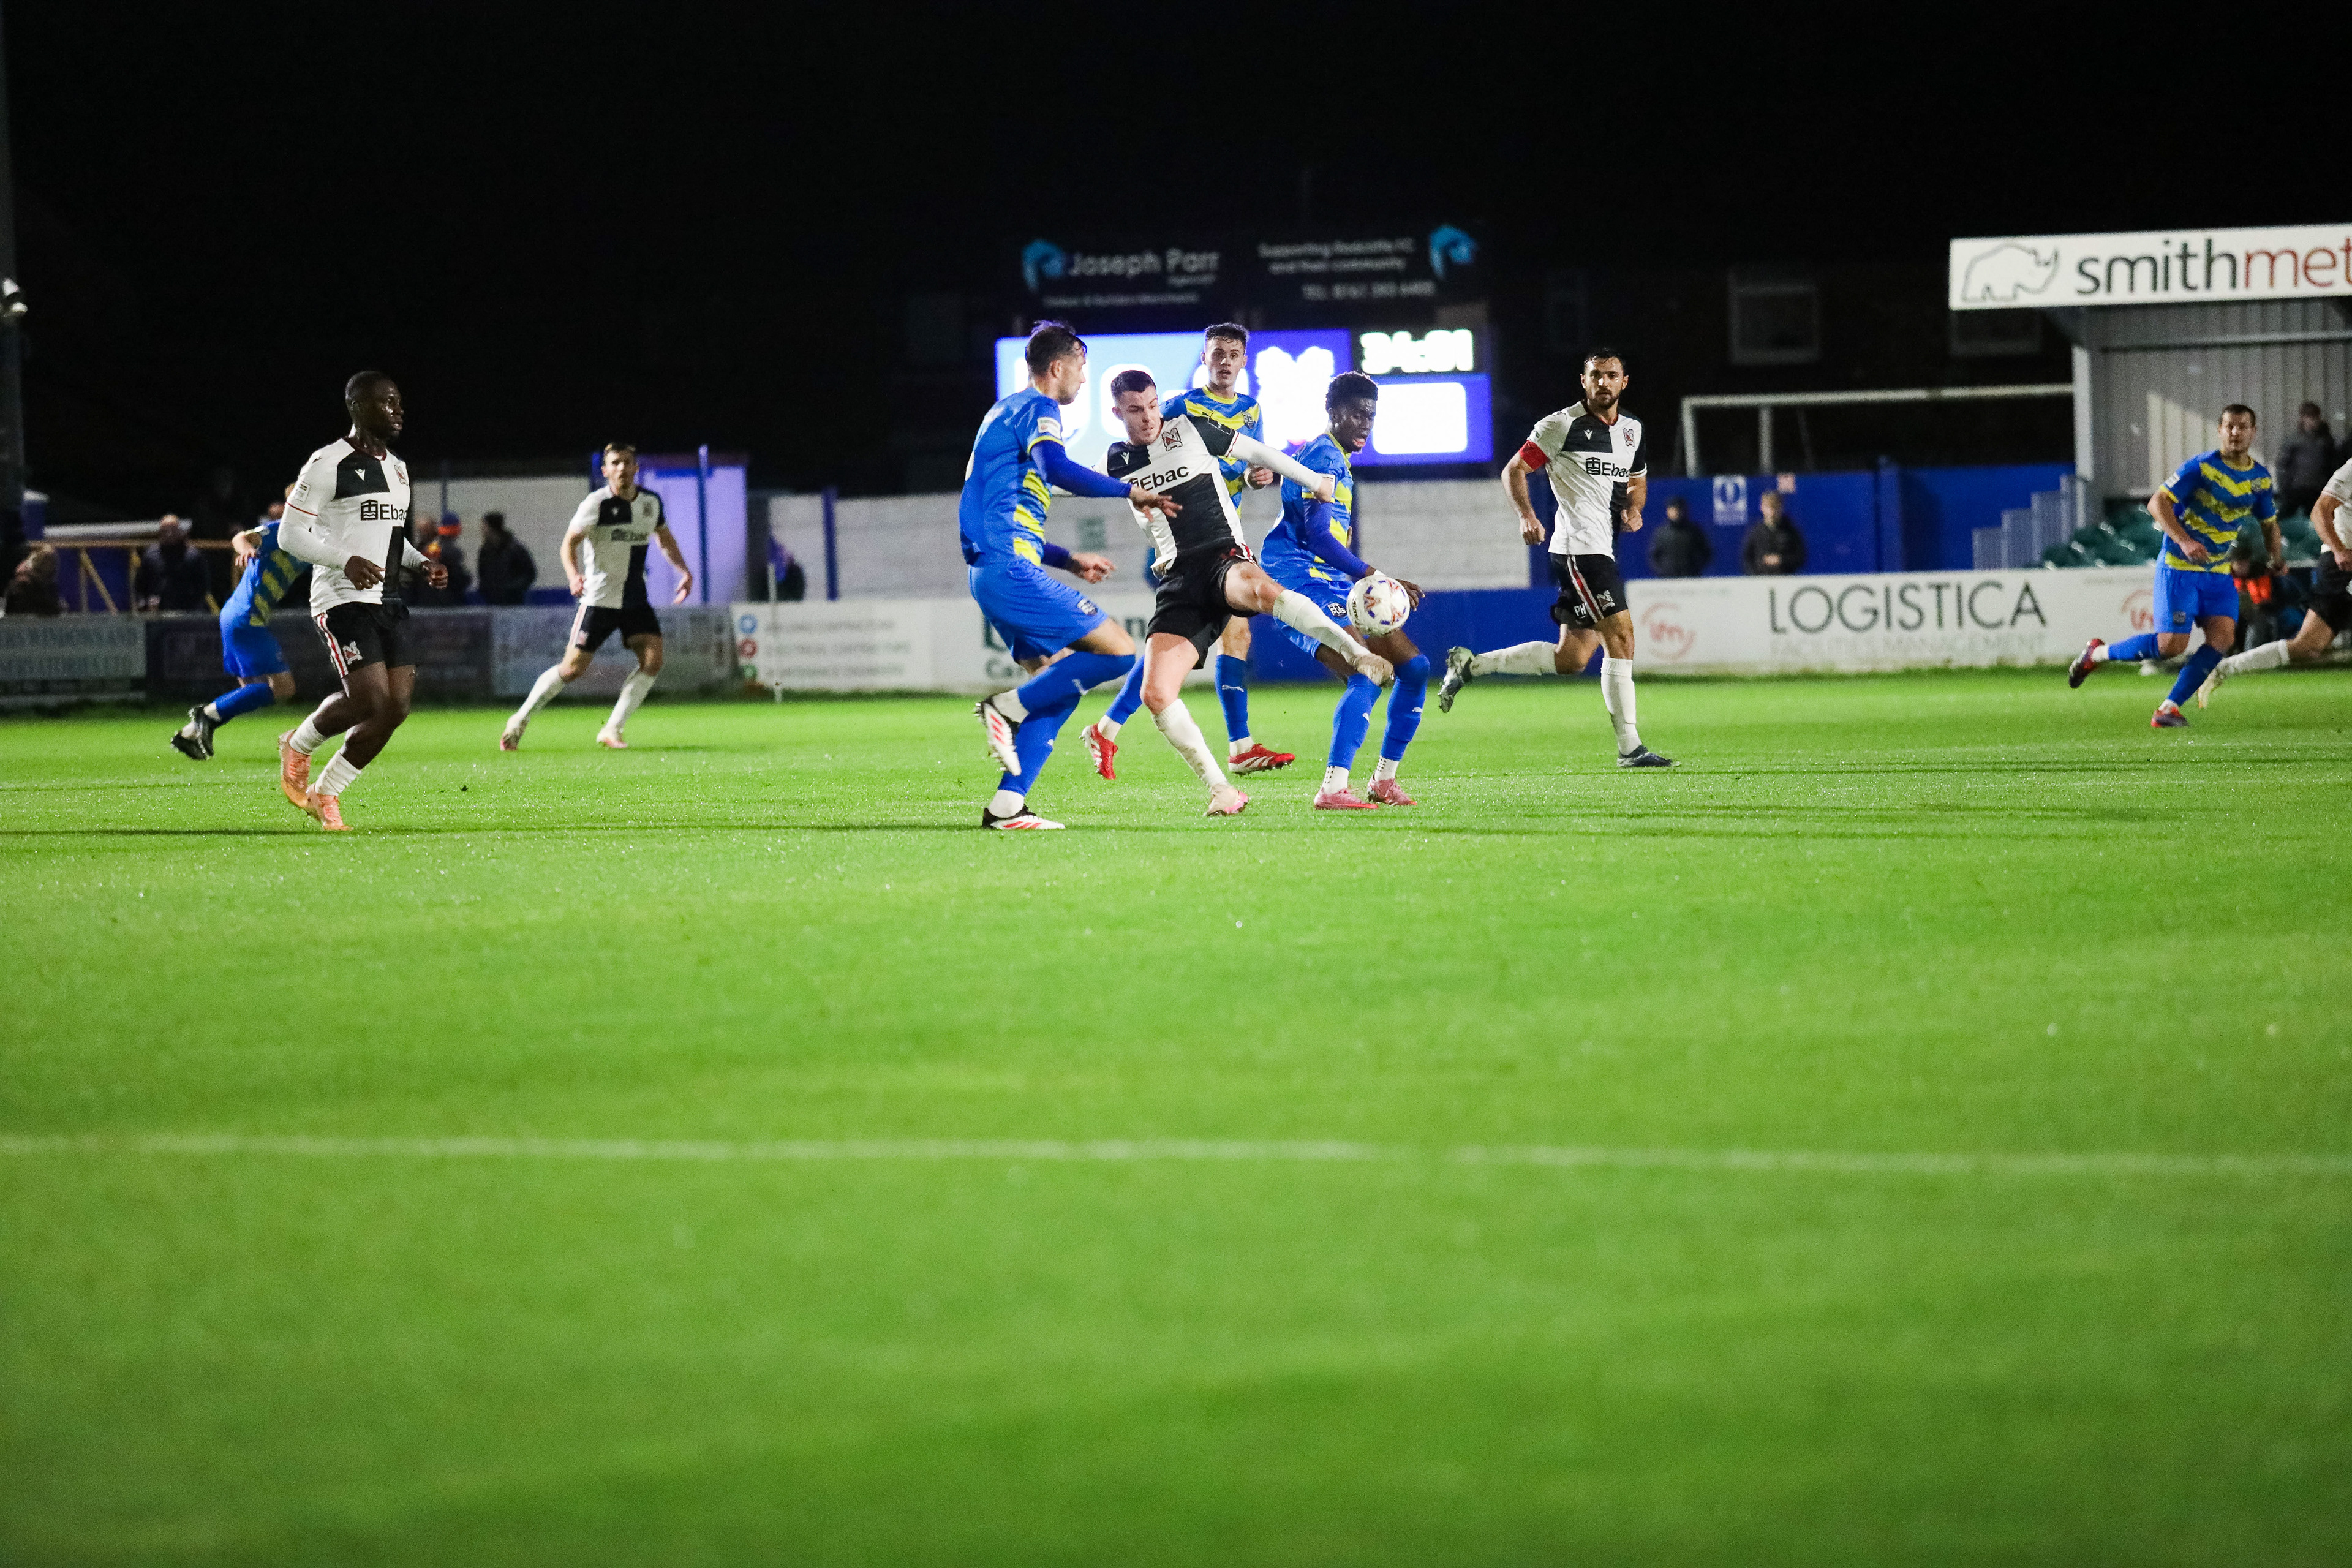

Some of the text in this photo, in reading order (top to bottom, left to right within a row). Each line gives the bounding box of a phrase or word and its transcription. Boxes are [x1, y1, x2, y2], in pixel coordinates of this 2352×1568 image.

[1069, 247, 1219, 279] Joseph Parr
[1140, 466, 1189, 491] Ebac
[1769, 579, 2047, 636] LOGISTICA
